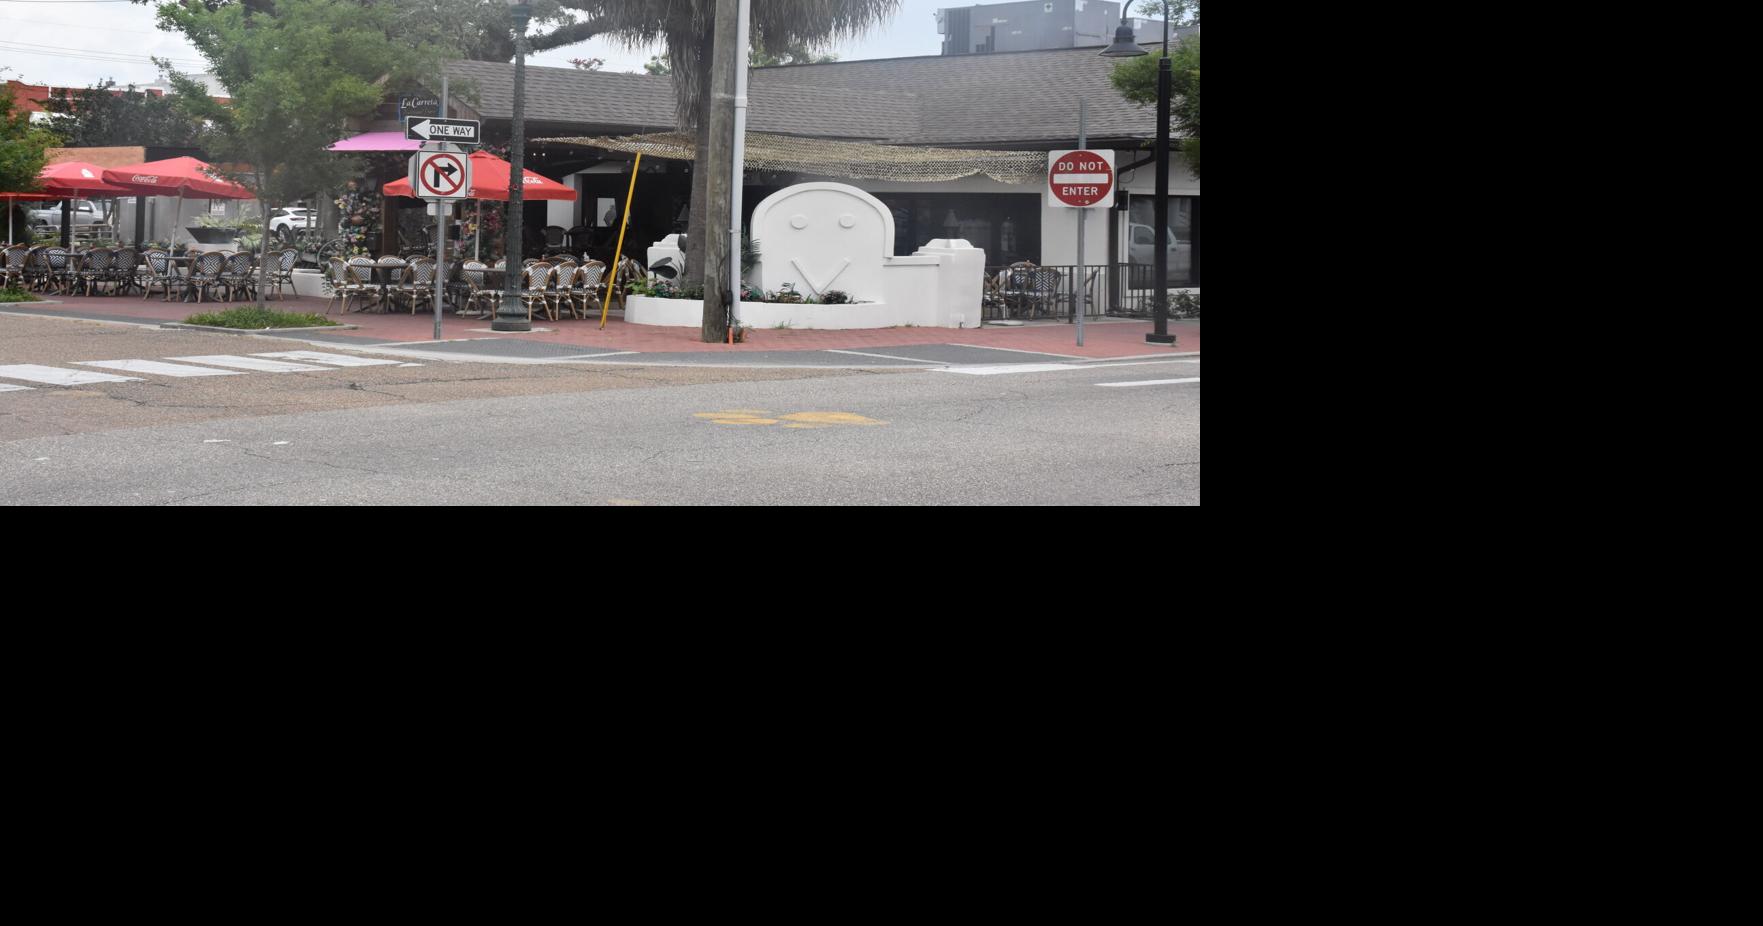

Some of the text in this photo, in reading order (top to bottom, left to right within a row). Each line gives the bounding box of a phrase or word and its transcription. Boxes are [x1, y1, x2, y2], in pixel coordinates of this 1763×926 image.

[401, 97, 411, 109] La
[429, 125, 472, 136] ONE WAY
[1058, 161, 1104, 171] DO NOT
[1062, 186, 1098, 196] ENTER
